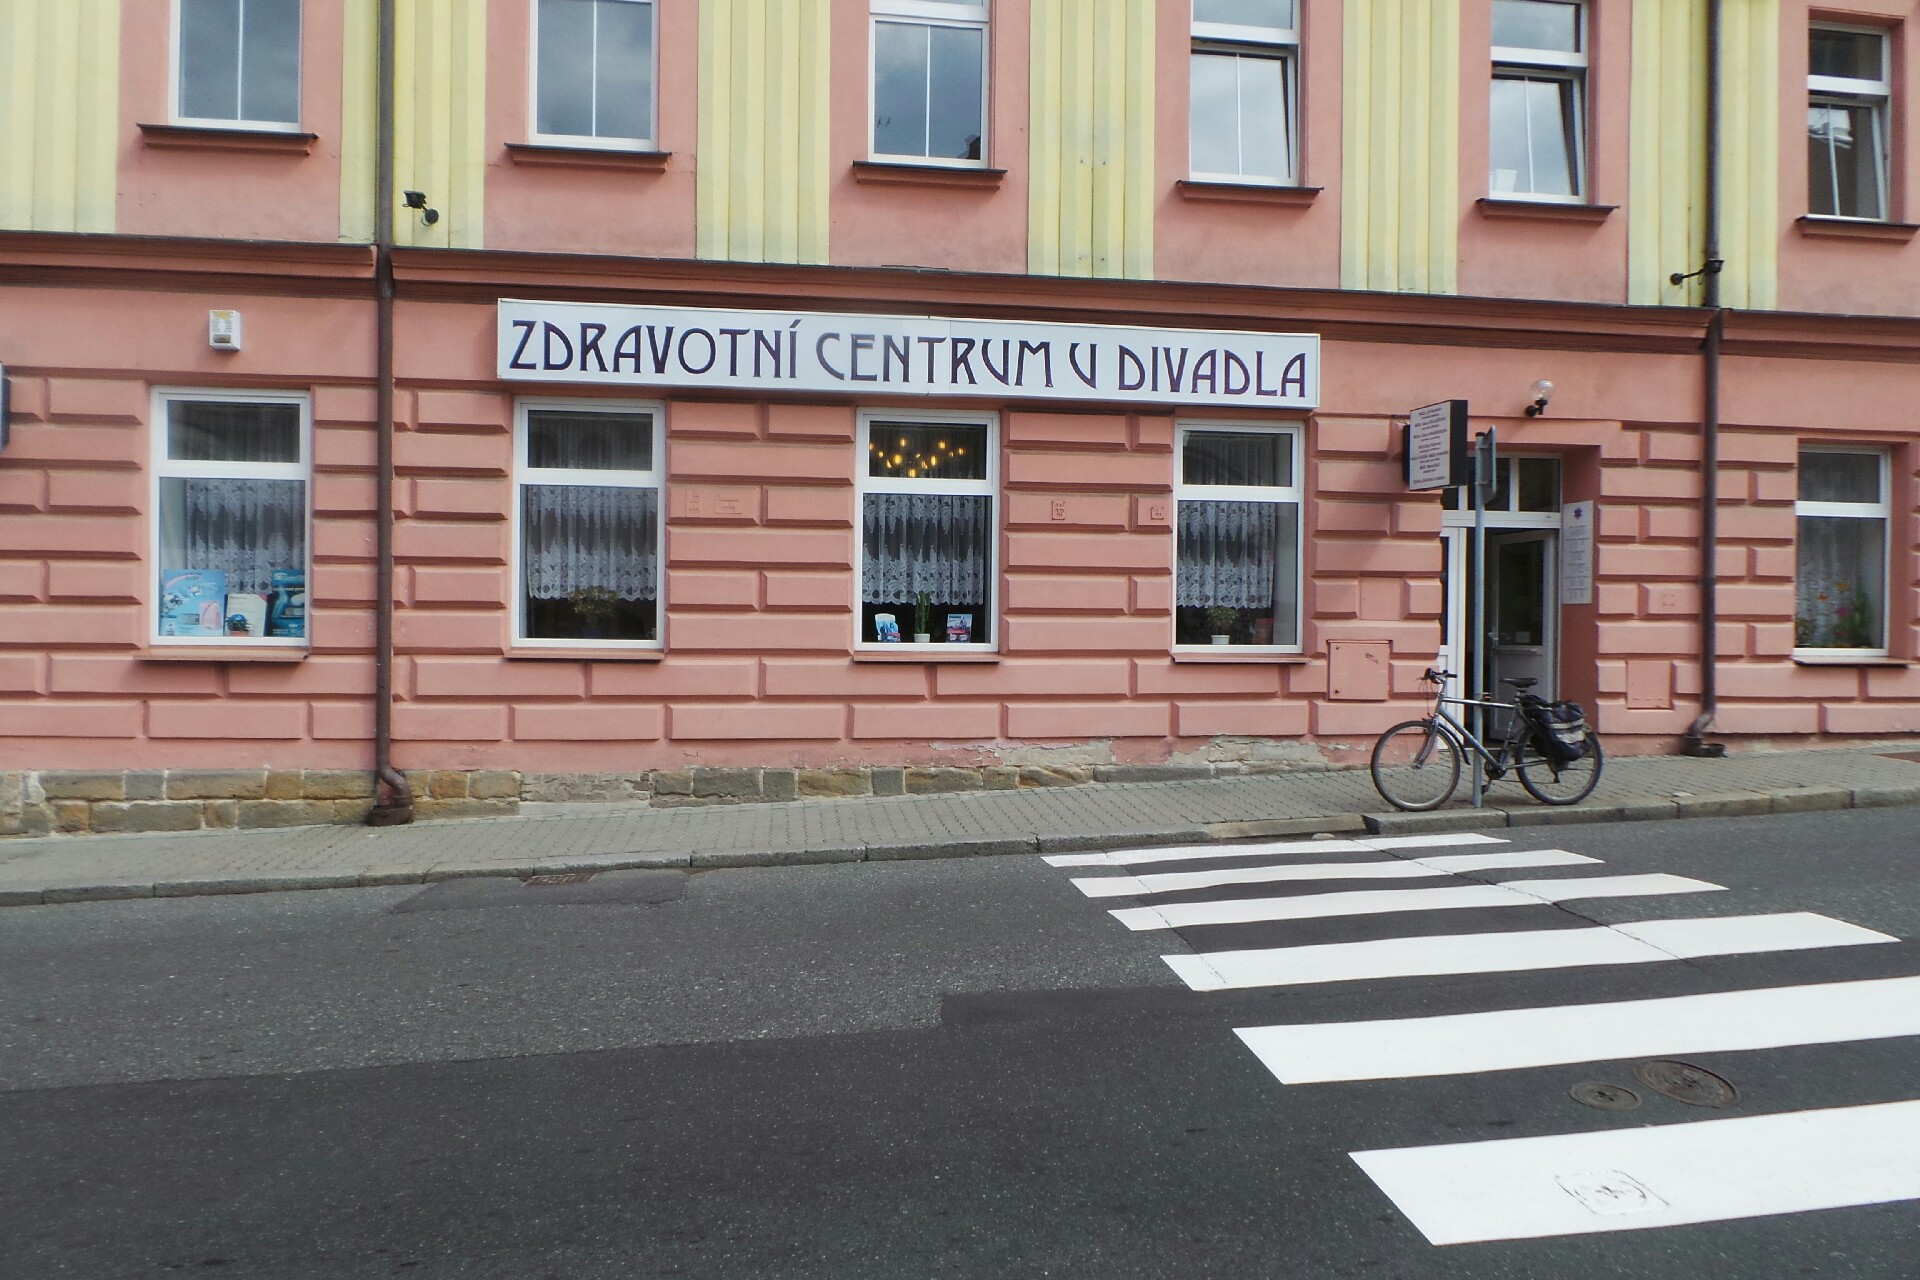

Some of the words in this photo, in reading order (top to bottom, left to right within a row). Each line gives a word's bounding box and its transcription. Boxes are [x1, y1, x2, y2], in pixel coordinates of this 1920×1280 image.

[509, 319, 801, 381] ZDRAVOTNÍ
[815, 332, 1054, 388] CENTRUM
[1068, 342, 1098, 390] U
[1117, 344, 1306, 398] DIVADLA
